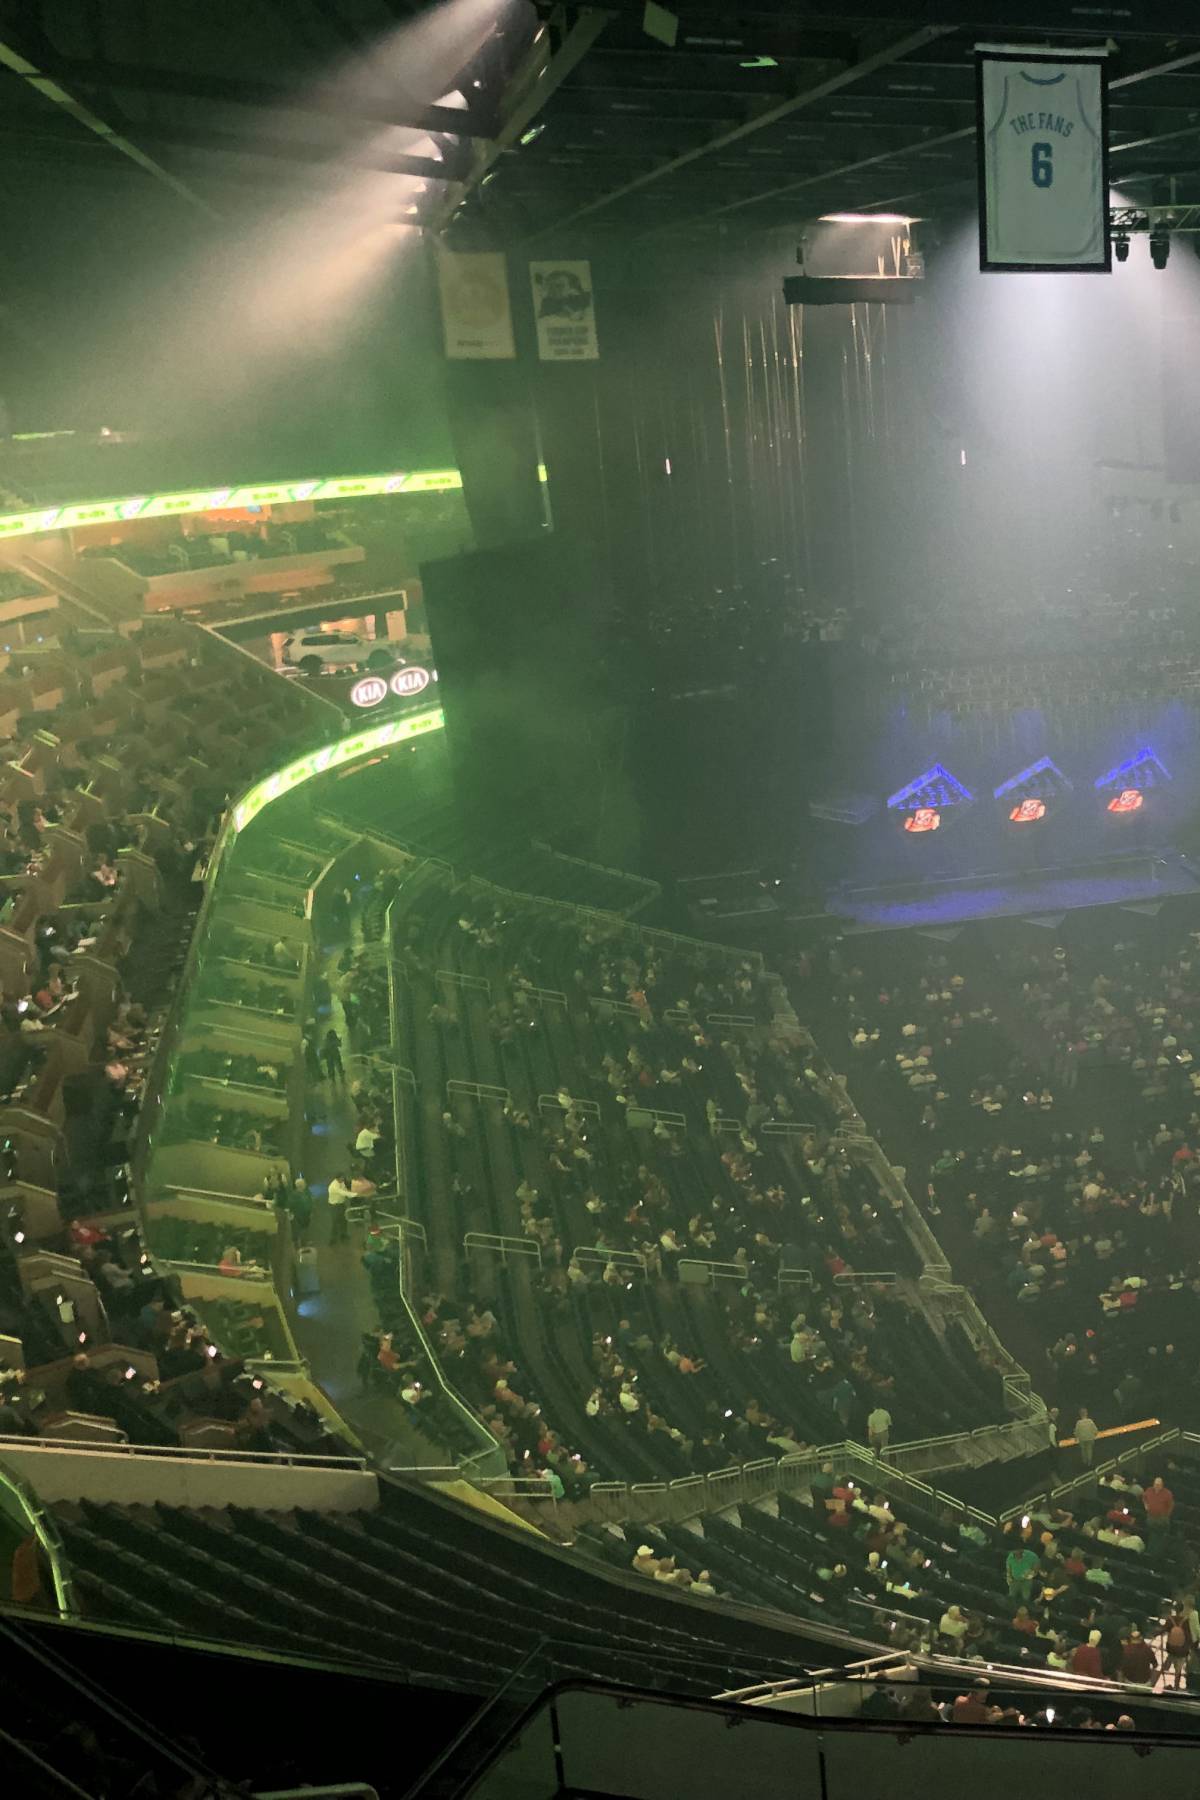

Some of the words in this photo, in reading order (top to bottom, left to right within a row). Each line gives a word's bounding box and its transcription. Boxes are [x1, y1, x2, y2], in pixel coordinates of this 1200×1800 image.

[1009, 112, 1036, 137] THE
[1037, 112, 1075, 138] FANS
[1031, 142, 1053, 188] 6
[357, 682, 382, 703] KIA
[397, 671, 424, 692] KIA
